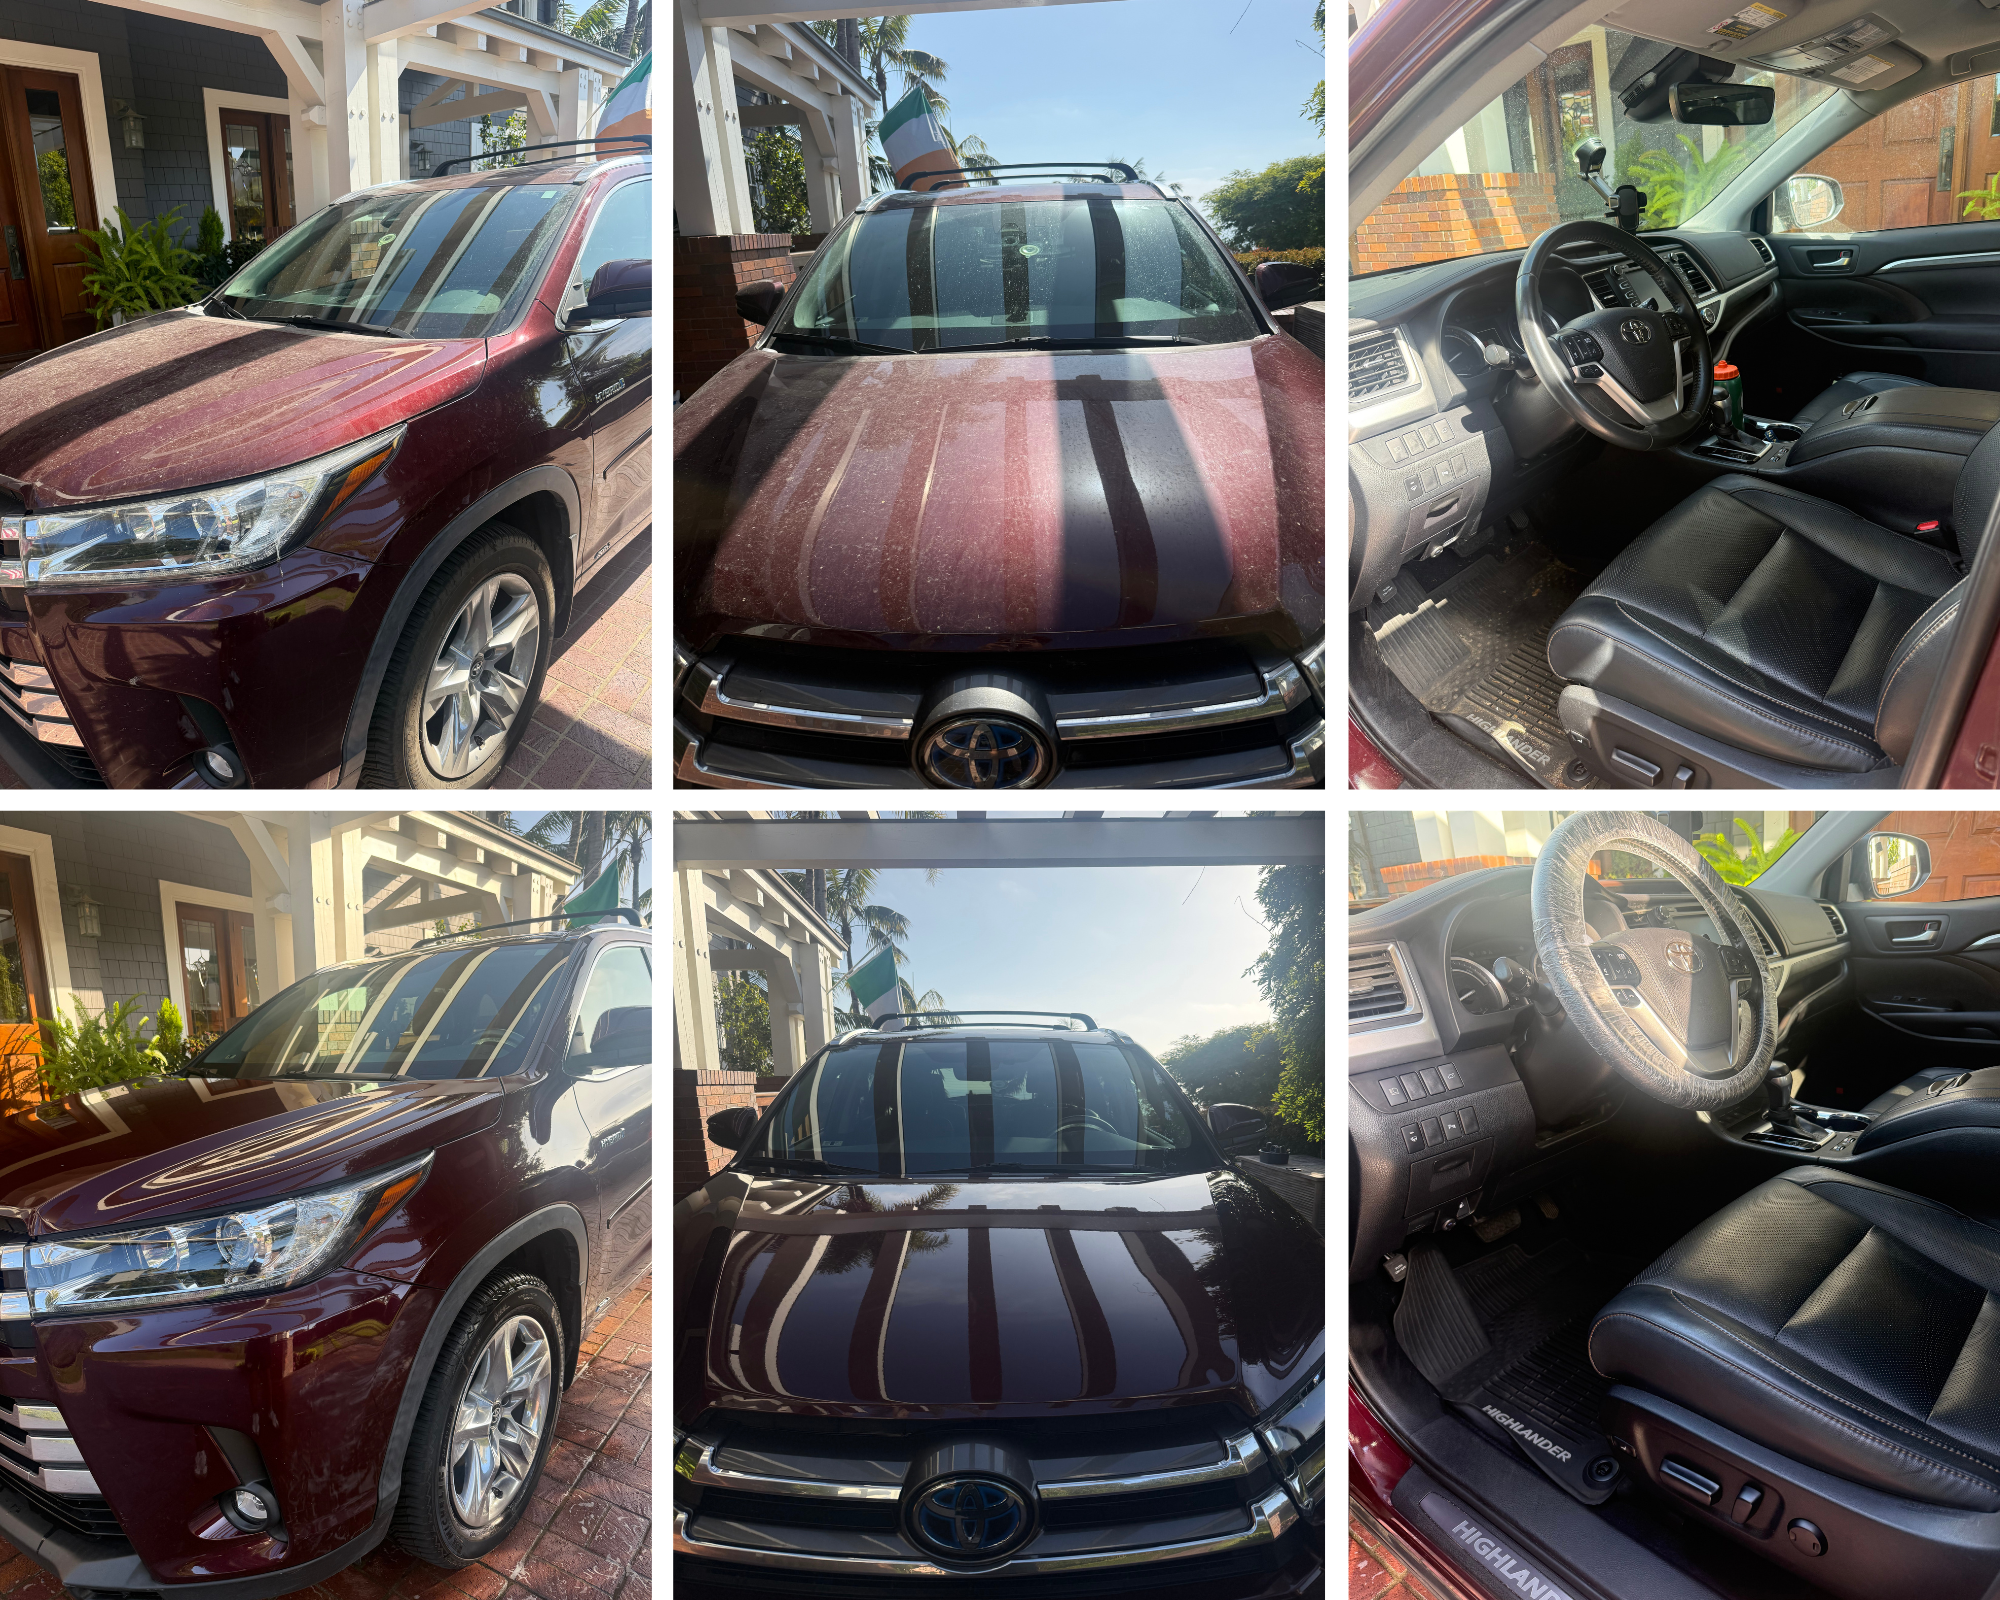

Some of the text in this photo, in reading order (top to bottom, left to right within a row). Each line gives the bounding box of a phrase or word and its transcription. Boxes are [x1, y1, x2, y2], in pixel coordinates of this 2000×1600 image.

[595, 381, 622, 403] HYBRID
[1466, 713, 1551, 766] HIGHLANDER
[1482, 1405, 1572, 1462] HIGHLANDER
